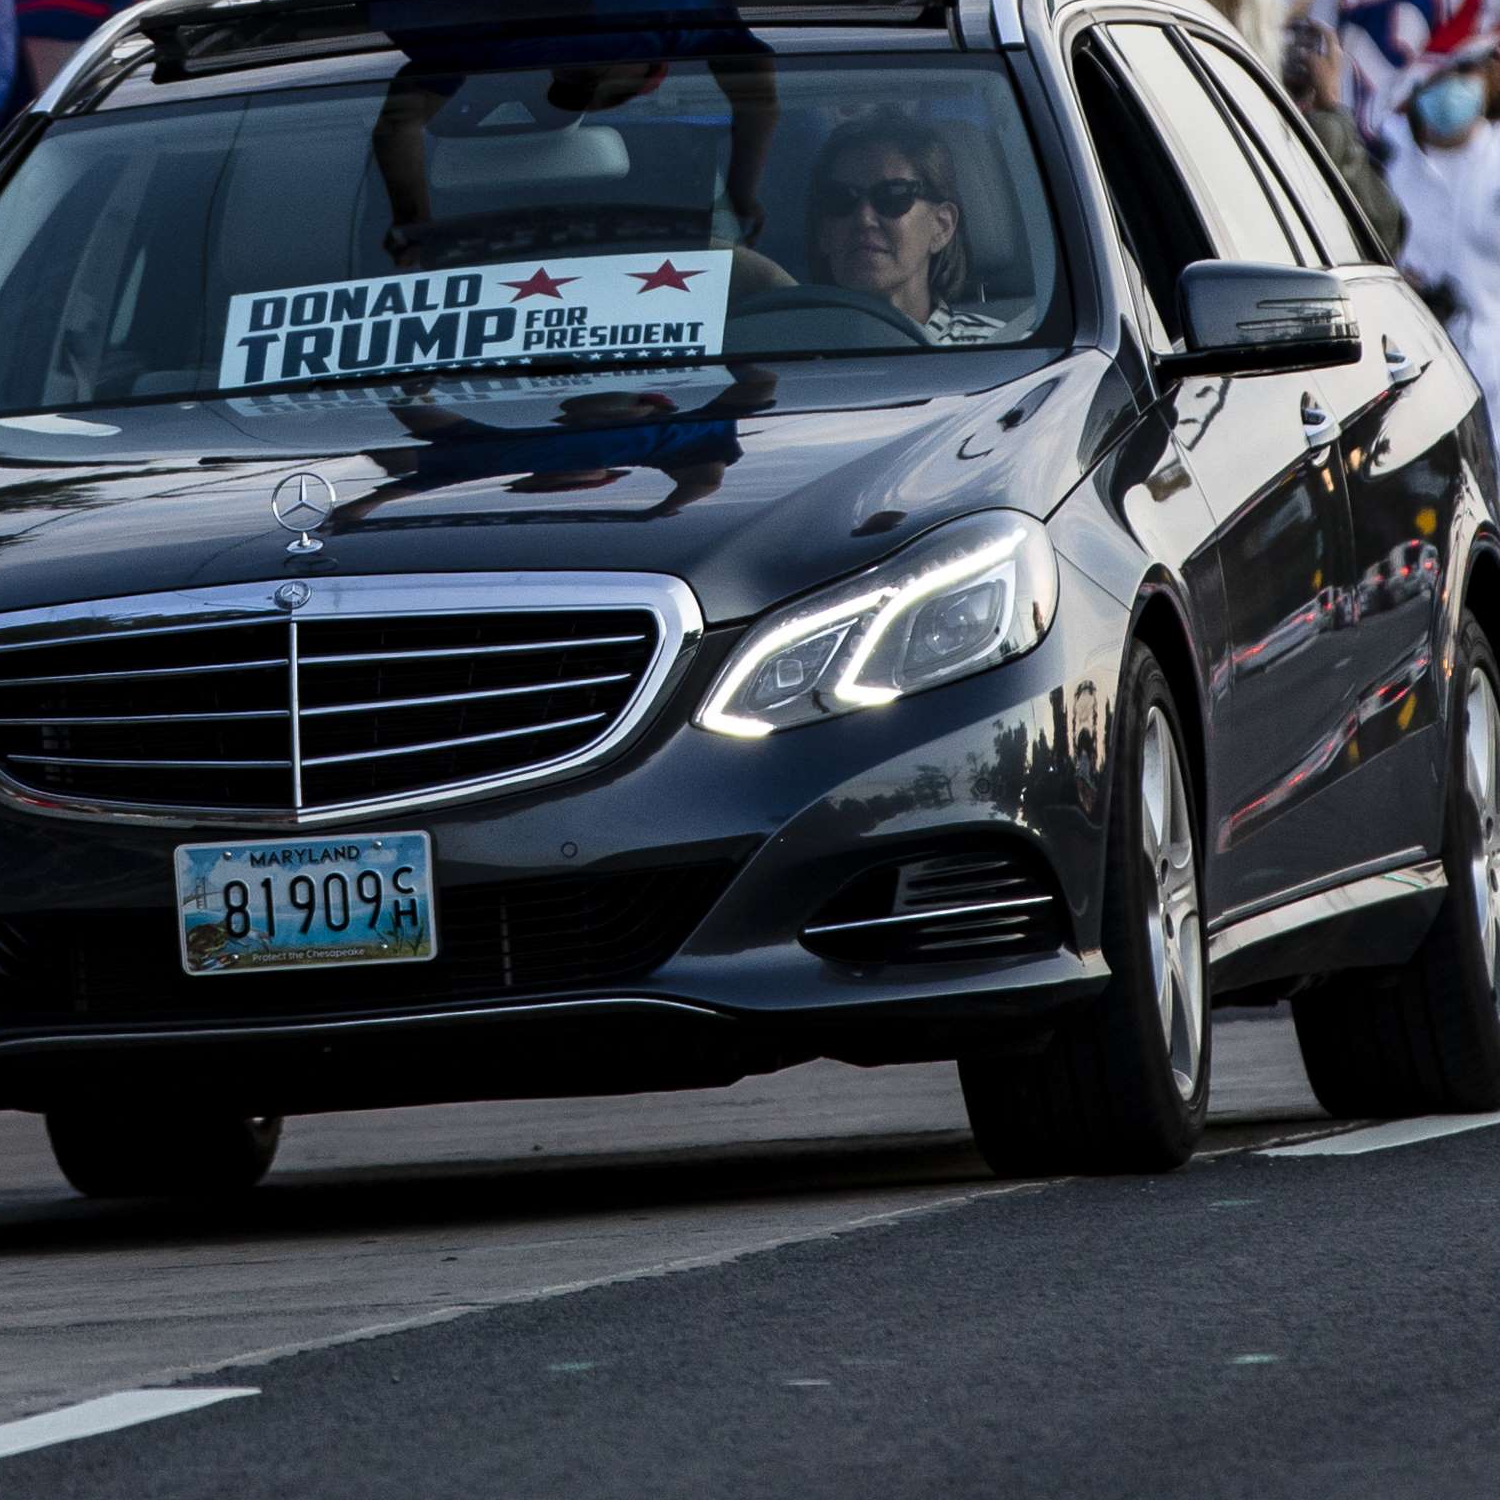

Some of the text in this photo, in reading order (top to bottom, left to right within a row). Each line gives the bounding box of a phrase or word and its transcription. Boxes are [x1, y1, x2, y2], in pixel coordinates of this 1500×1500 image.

[250, 273, 483, 332] DONALD
[524, 306, 588, 329] FOR
[236, 306, 518, 378] TRUMP
[523, 320, 704, 350] PRESIDENT
[250, 845, 361, 868] MARYLAND
[223, 869, 384, 939] 81909
[252, 948, 366, 962] Protect the Chesapeake
